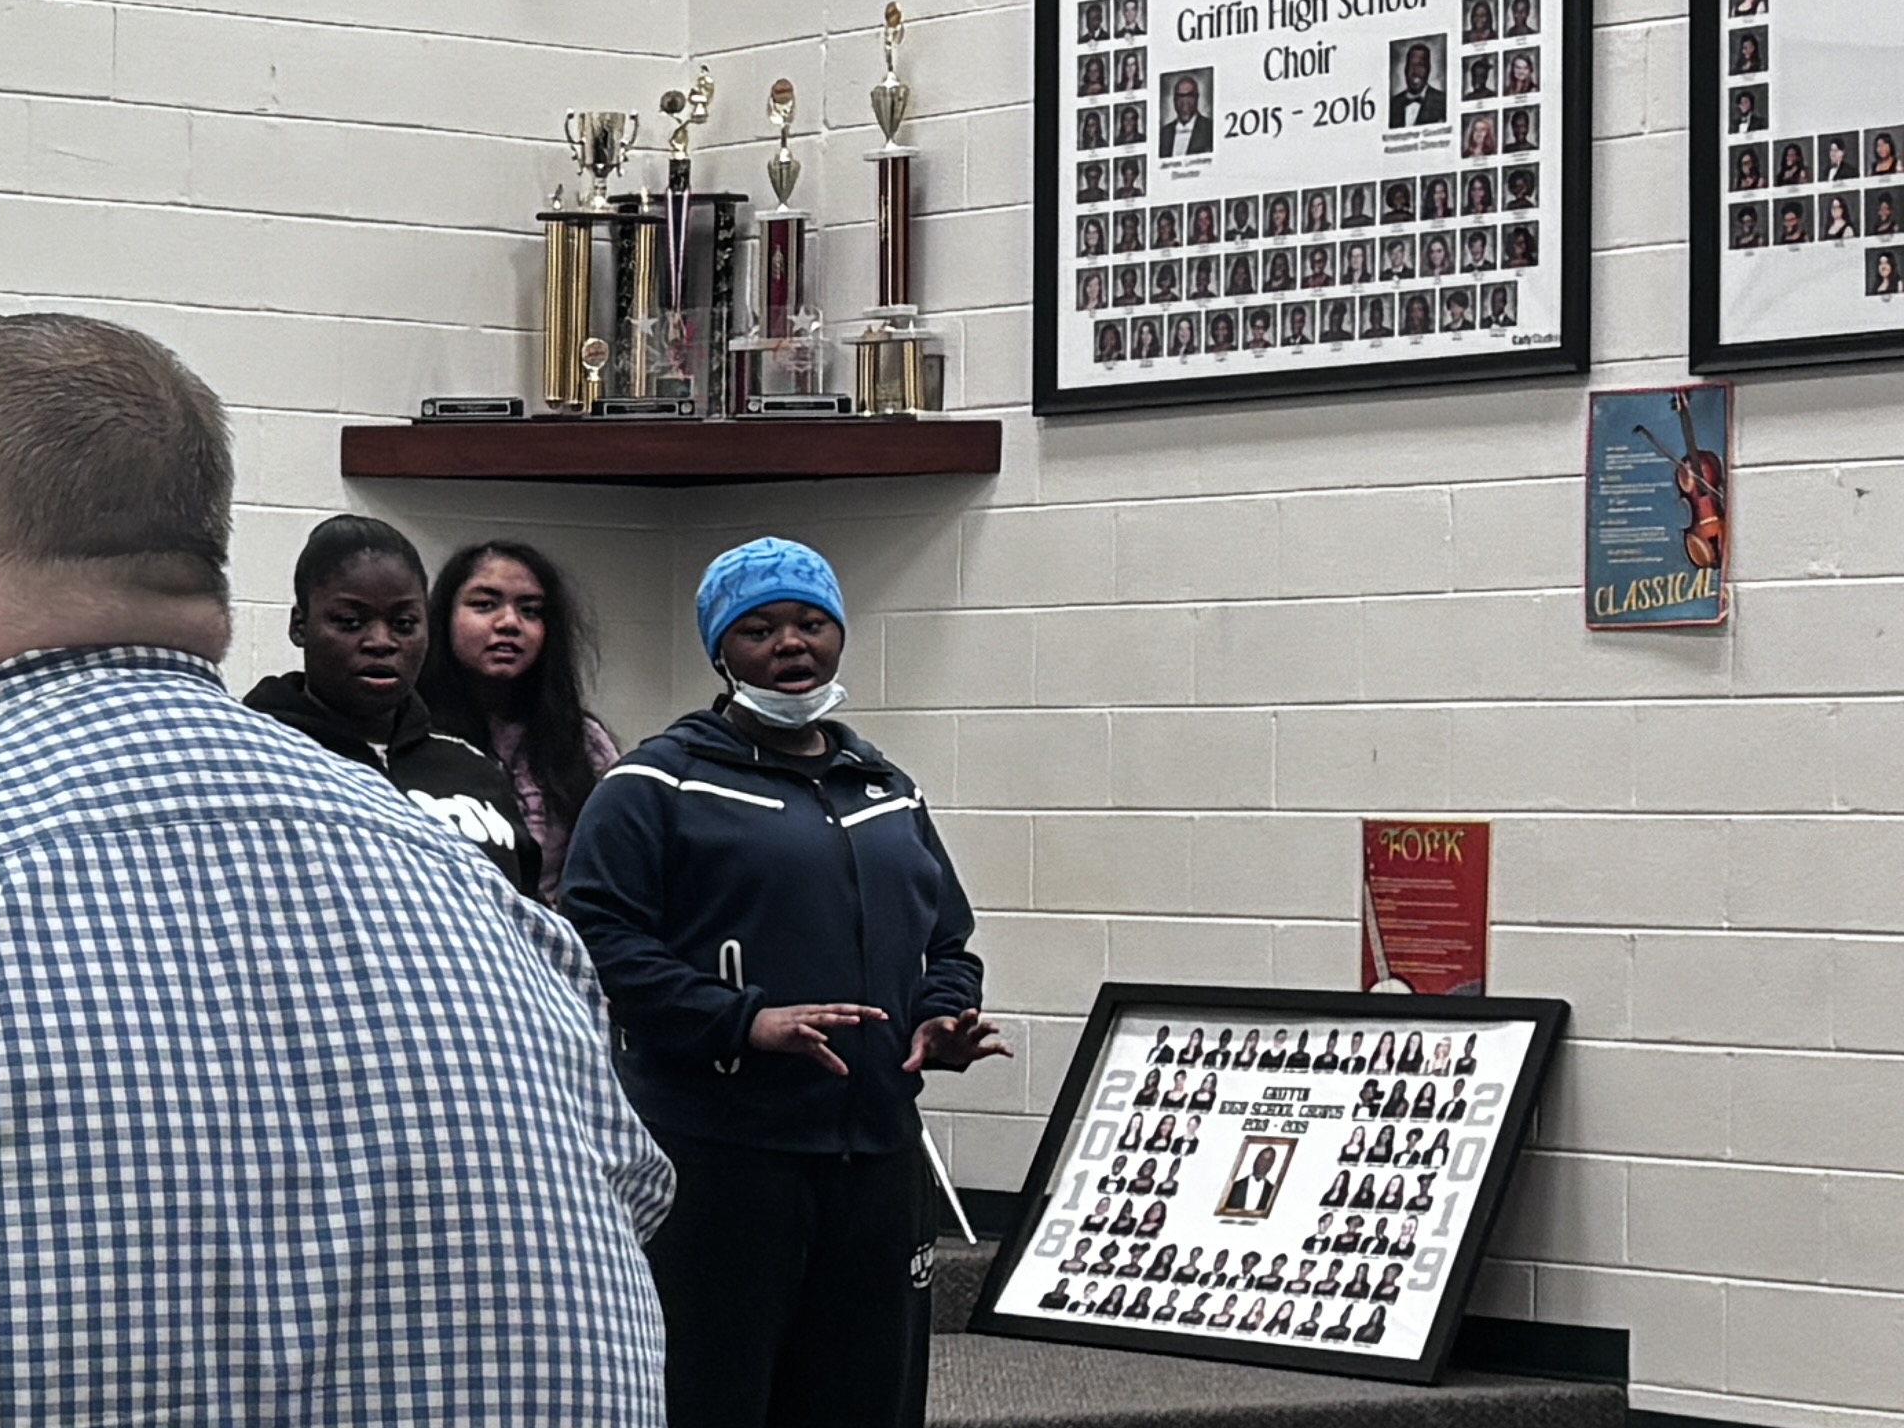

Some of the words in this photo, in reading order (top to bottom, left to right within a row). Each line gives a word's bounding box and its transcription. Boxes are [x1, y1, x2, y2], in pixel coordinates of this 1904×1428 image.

[1176, 0, 1259, 43] Griffin
[1263, 40, 1338, 82] Choir
[1224, 106, 1283, 139] 2015
[1312, 86, 1376, 128] 2016
[1594, 568, 1719, 617] CLASSICAL
[1379, 826, 1467, 864] FOLK
